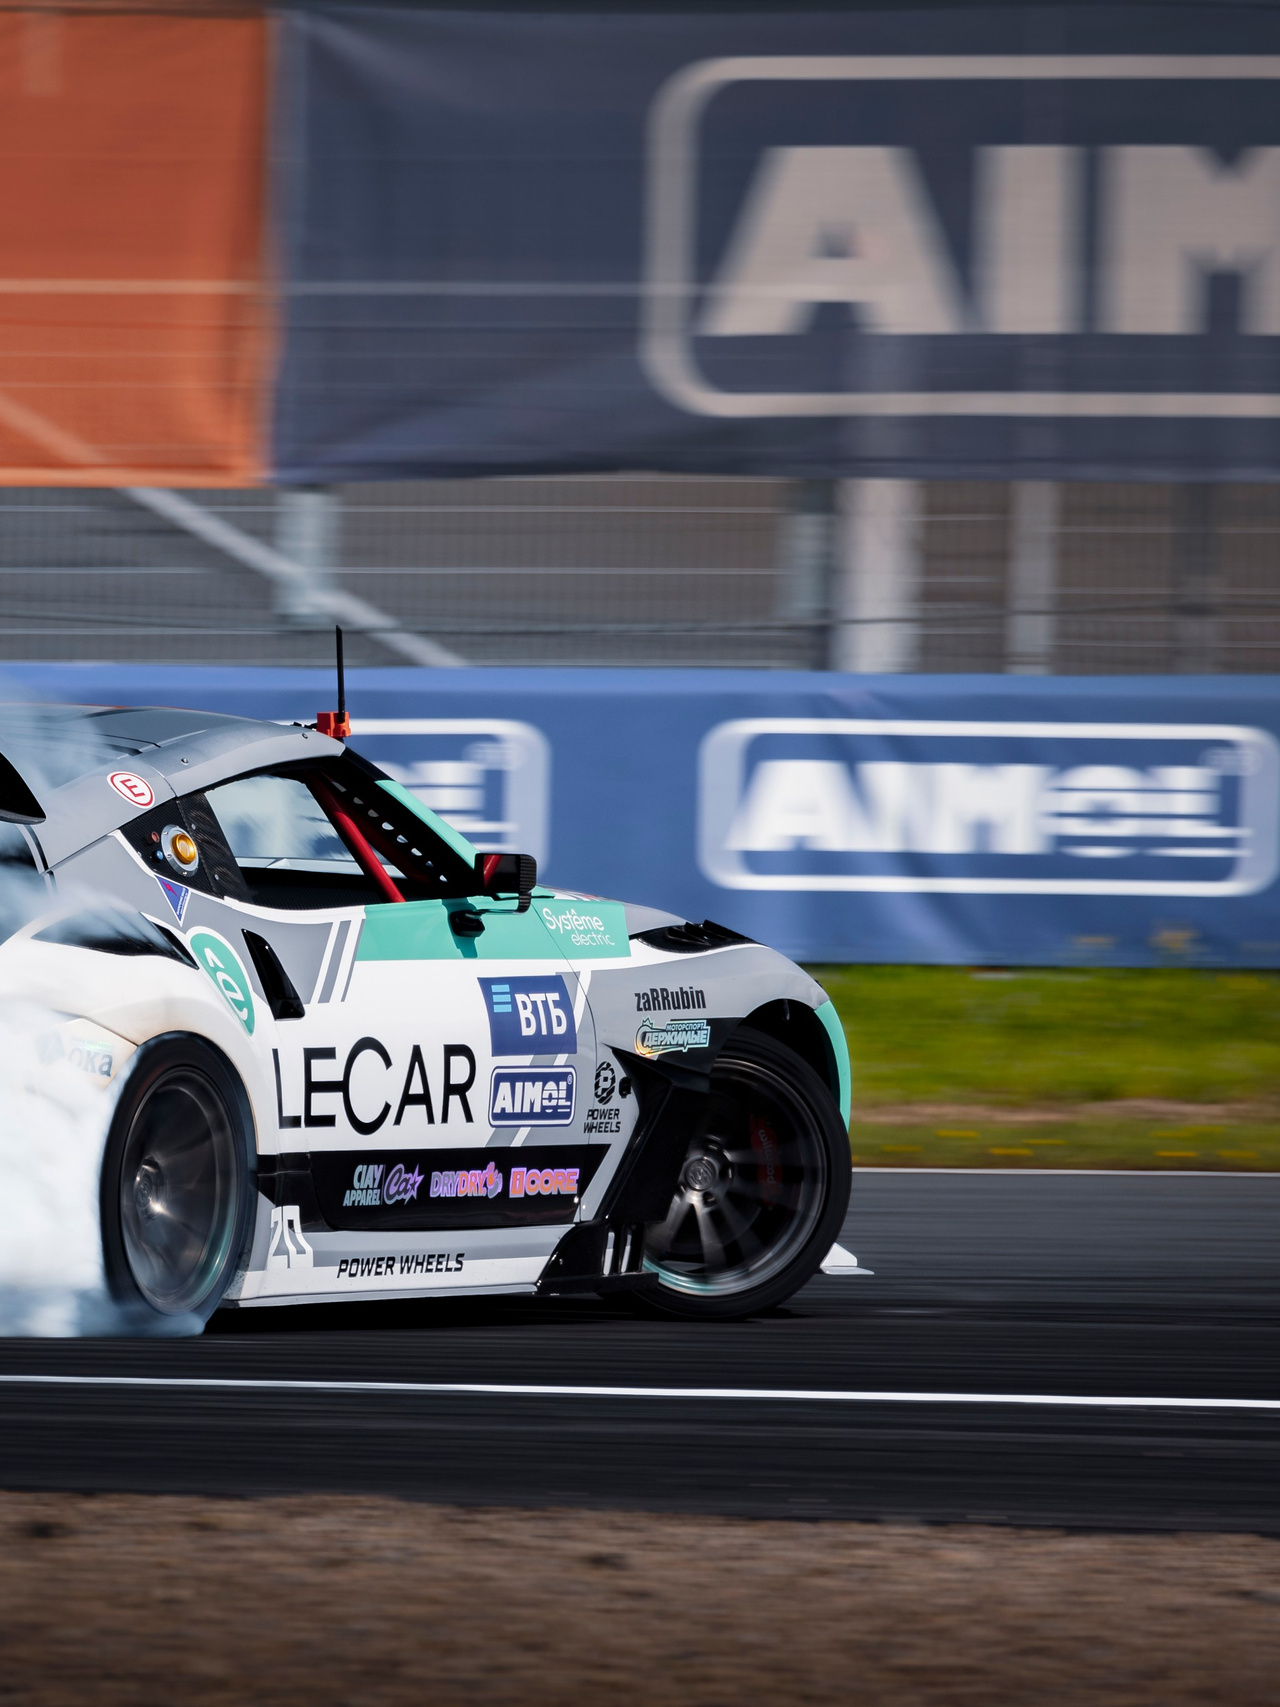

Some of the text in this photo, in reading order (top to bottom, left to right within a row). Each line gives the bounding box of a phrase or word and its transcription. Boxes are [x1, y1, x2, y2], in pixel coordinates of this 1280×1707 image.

[120, 777, 145, 798] E
[723, 759, 1254, 858] AIMOL
[542, 907, 604, 934] Systême
[571, 930, 615, 946] electric
[634, 986, 707, 1012] zaRRubin
[514, 992, 567, 1037] ВТБ
[666, 1022, 704, 1032] МОТОРСПОРТ
[272, 1036, 477, 1135] LECAR
[493, 1080, 571, 1114] AIMOL
[583, 1121, 621, 1134] WHEELS
[586, 1108, 620, 1121] POWER
[342, 1188, 381, 1207] APPAREL
[337, 1253, 465, 1279] POWER WHEELS
